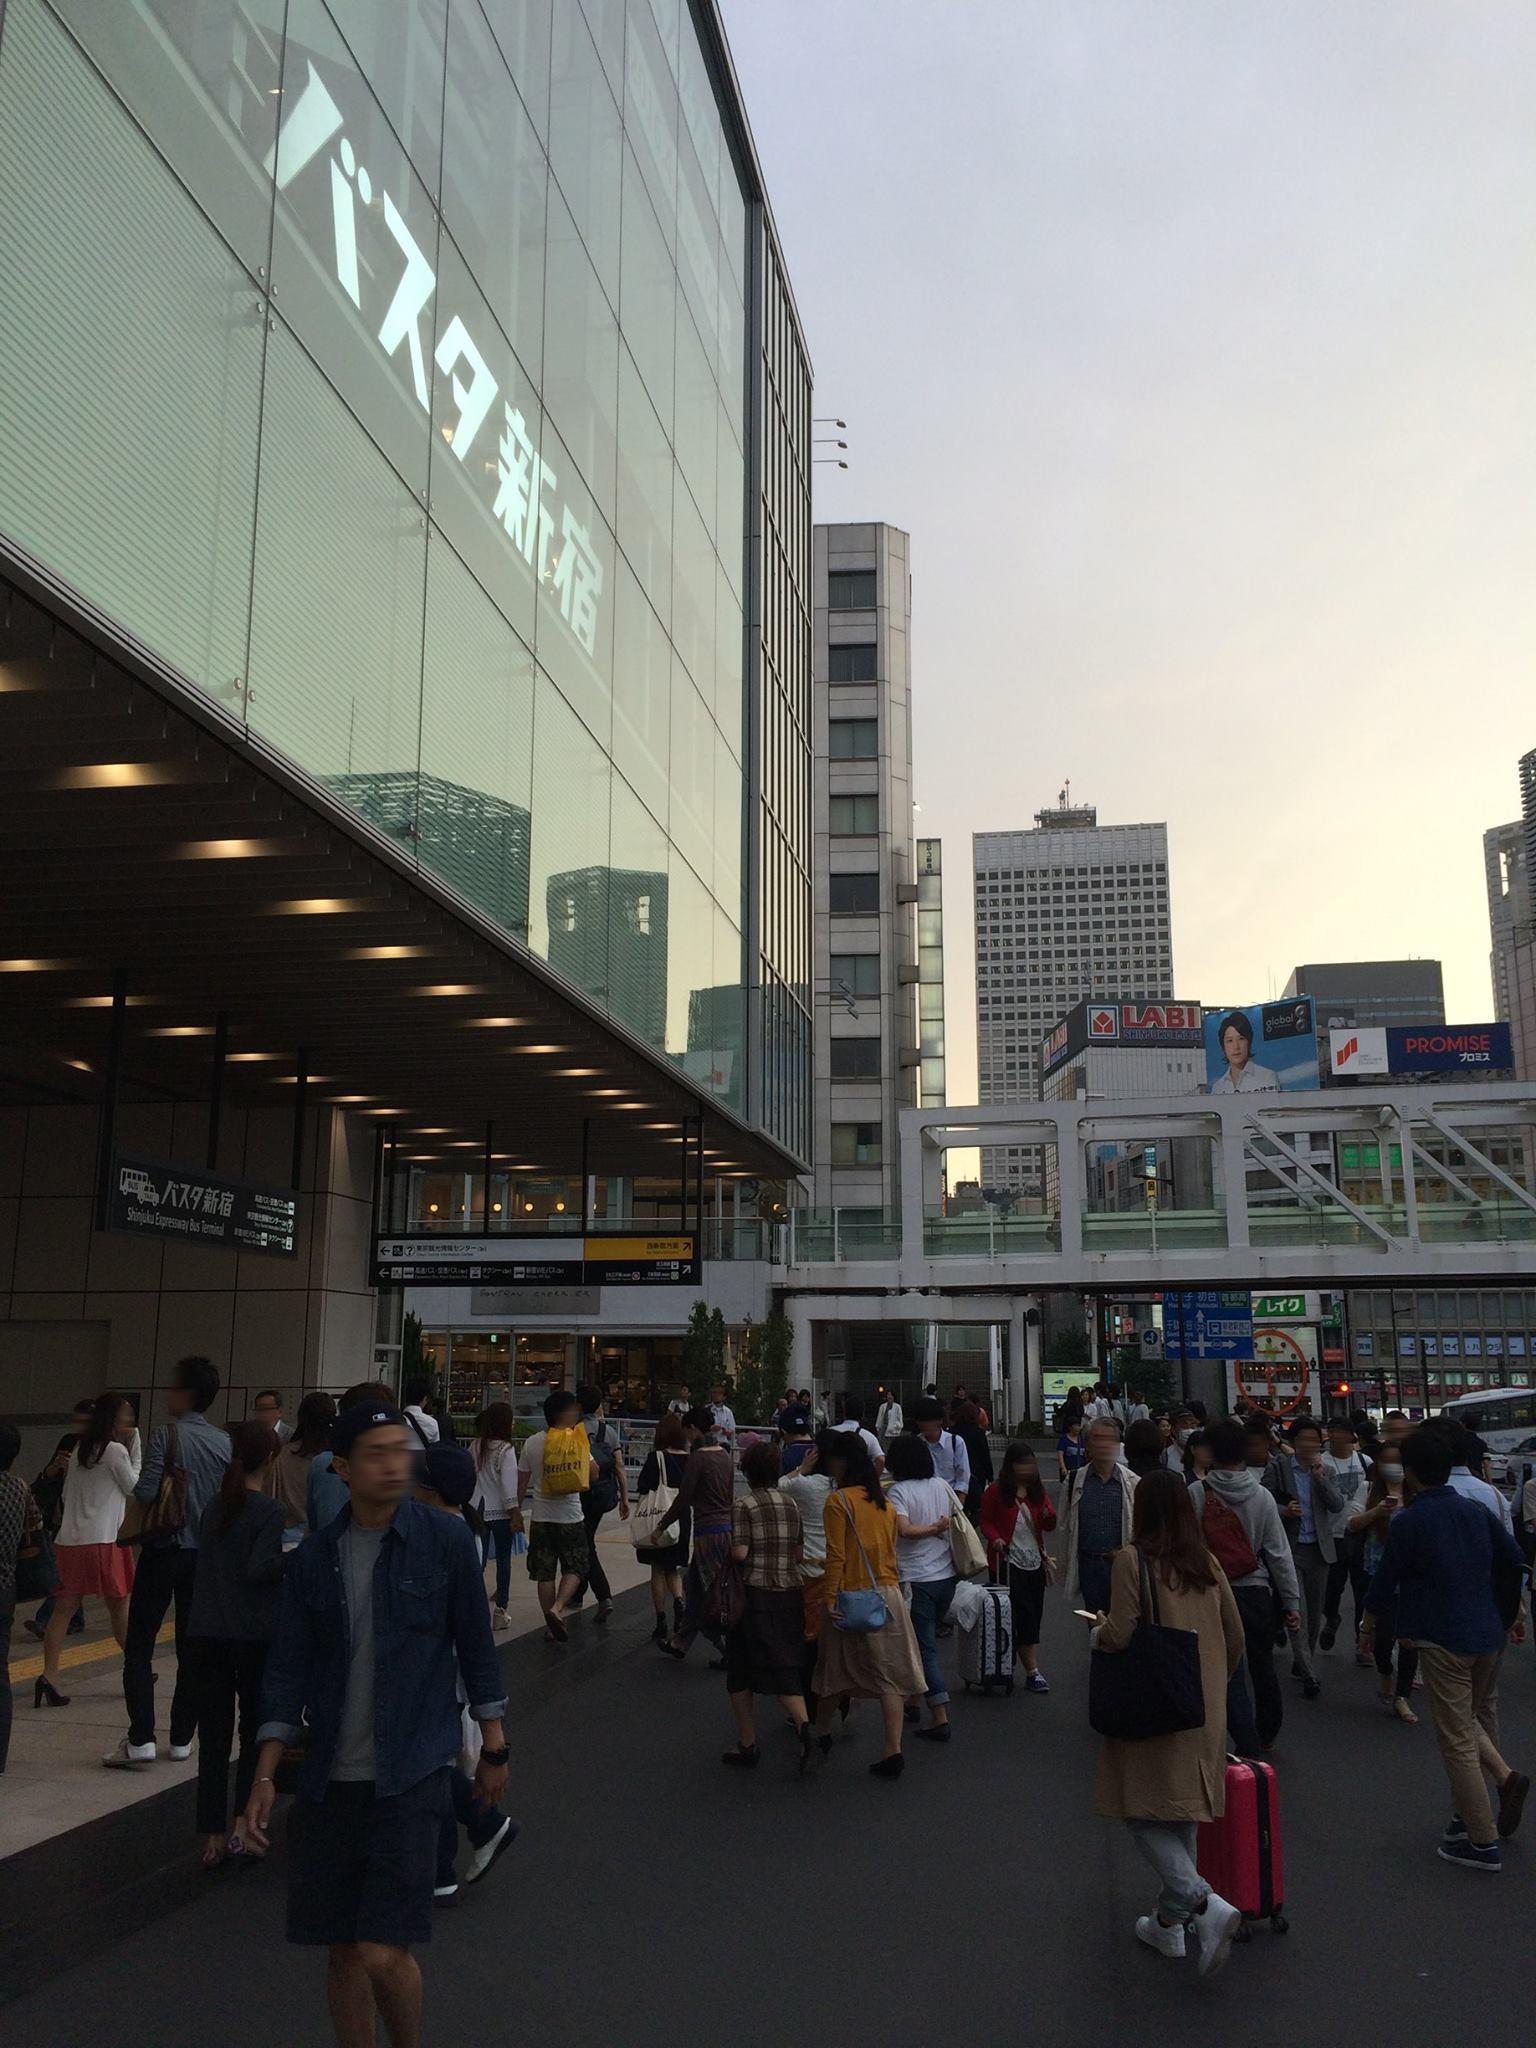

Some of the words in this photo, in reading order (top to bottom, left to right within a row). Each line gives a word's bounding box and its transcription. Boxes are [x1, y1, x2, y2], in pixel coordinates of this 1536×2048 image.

[263, 58, 602, 658] バスタ新宿
[1122, 1006, 1201, 1029] LABI
[1265, 1013, 1295, 1033] global
[1406, 1034, 1491, 1054] PROMISE
[1459, 1052, 1491, 1063] プロミス
[161, 1180, 235, 1217] バスタ新宿
[127, 1206, 155, 1226] Shinjuku
[155, 1212, 189, 1233] Expressway
[190, 1218, 200, 1233] Bus
[202, 1220, 225, 1236] Terminal
[1266, 1298, 1300, 1313] レイク
